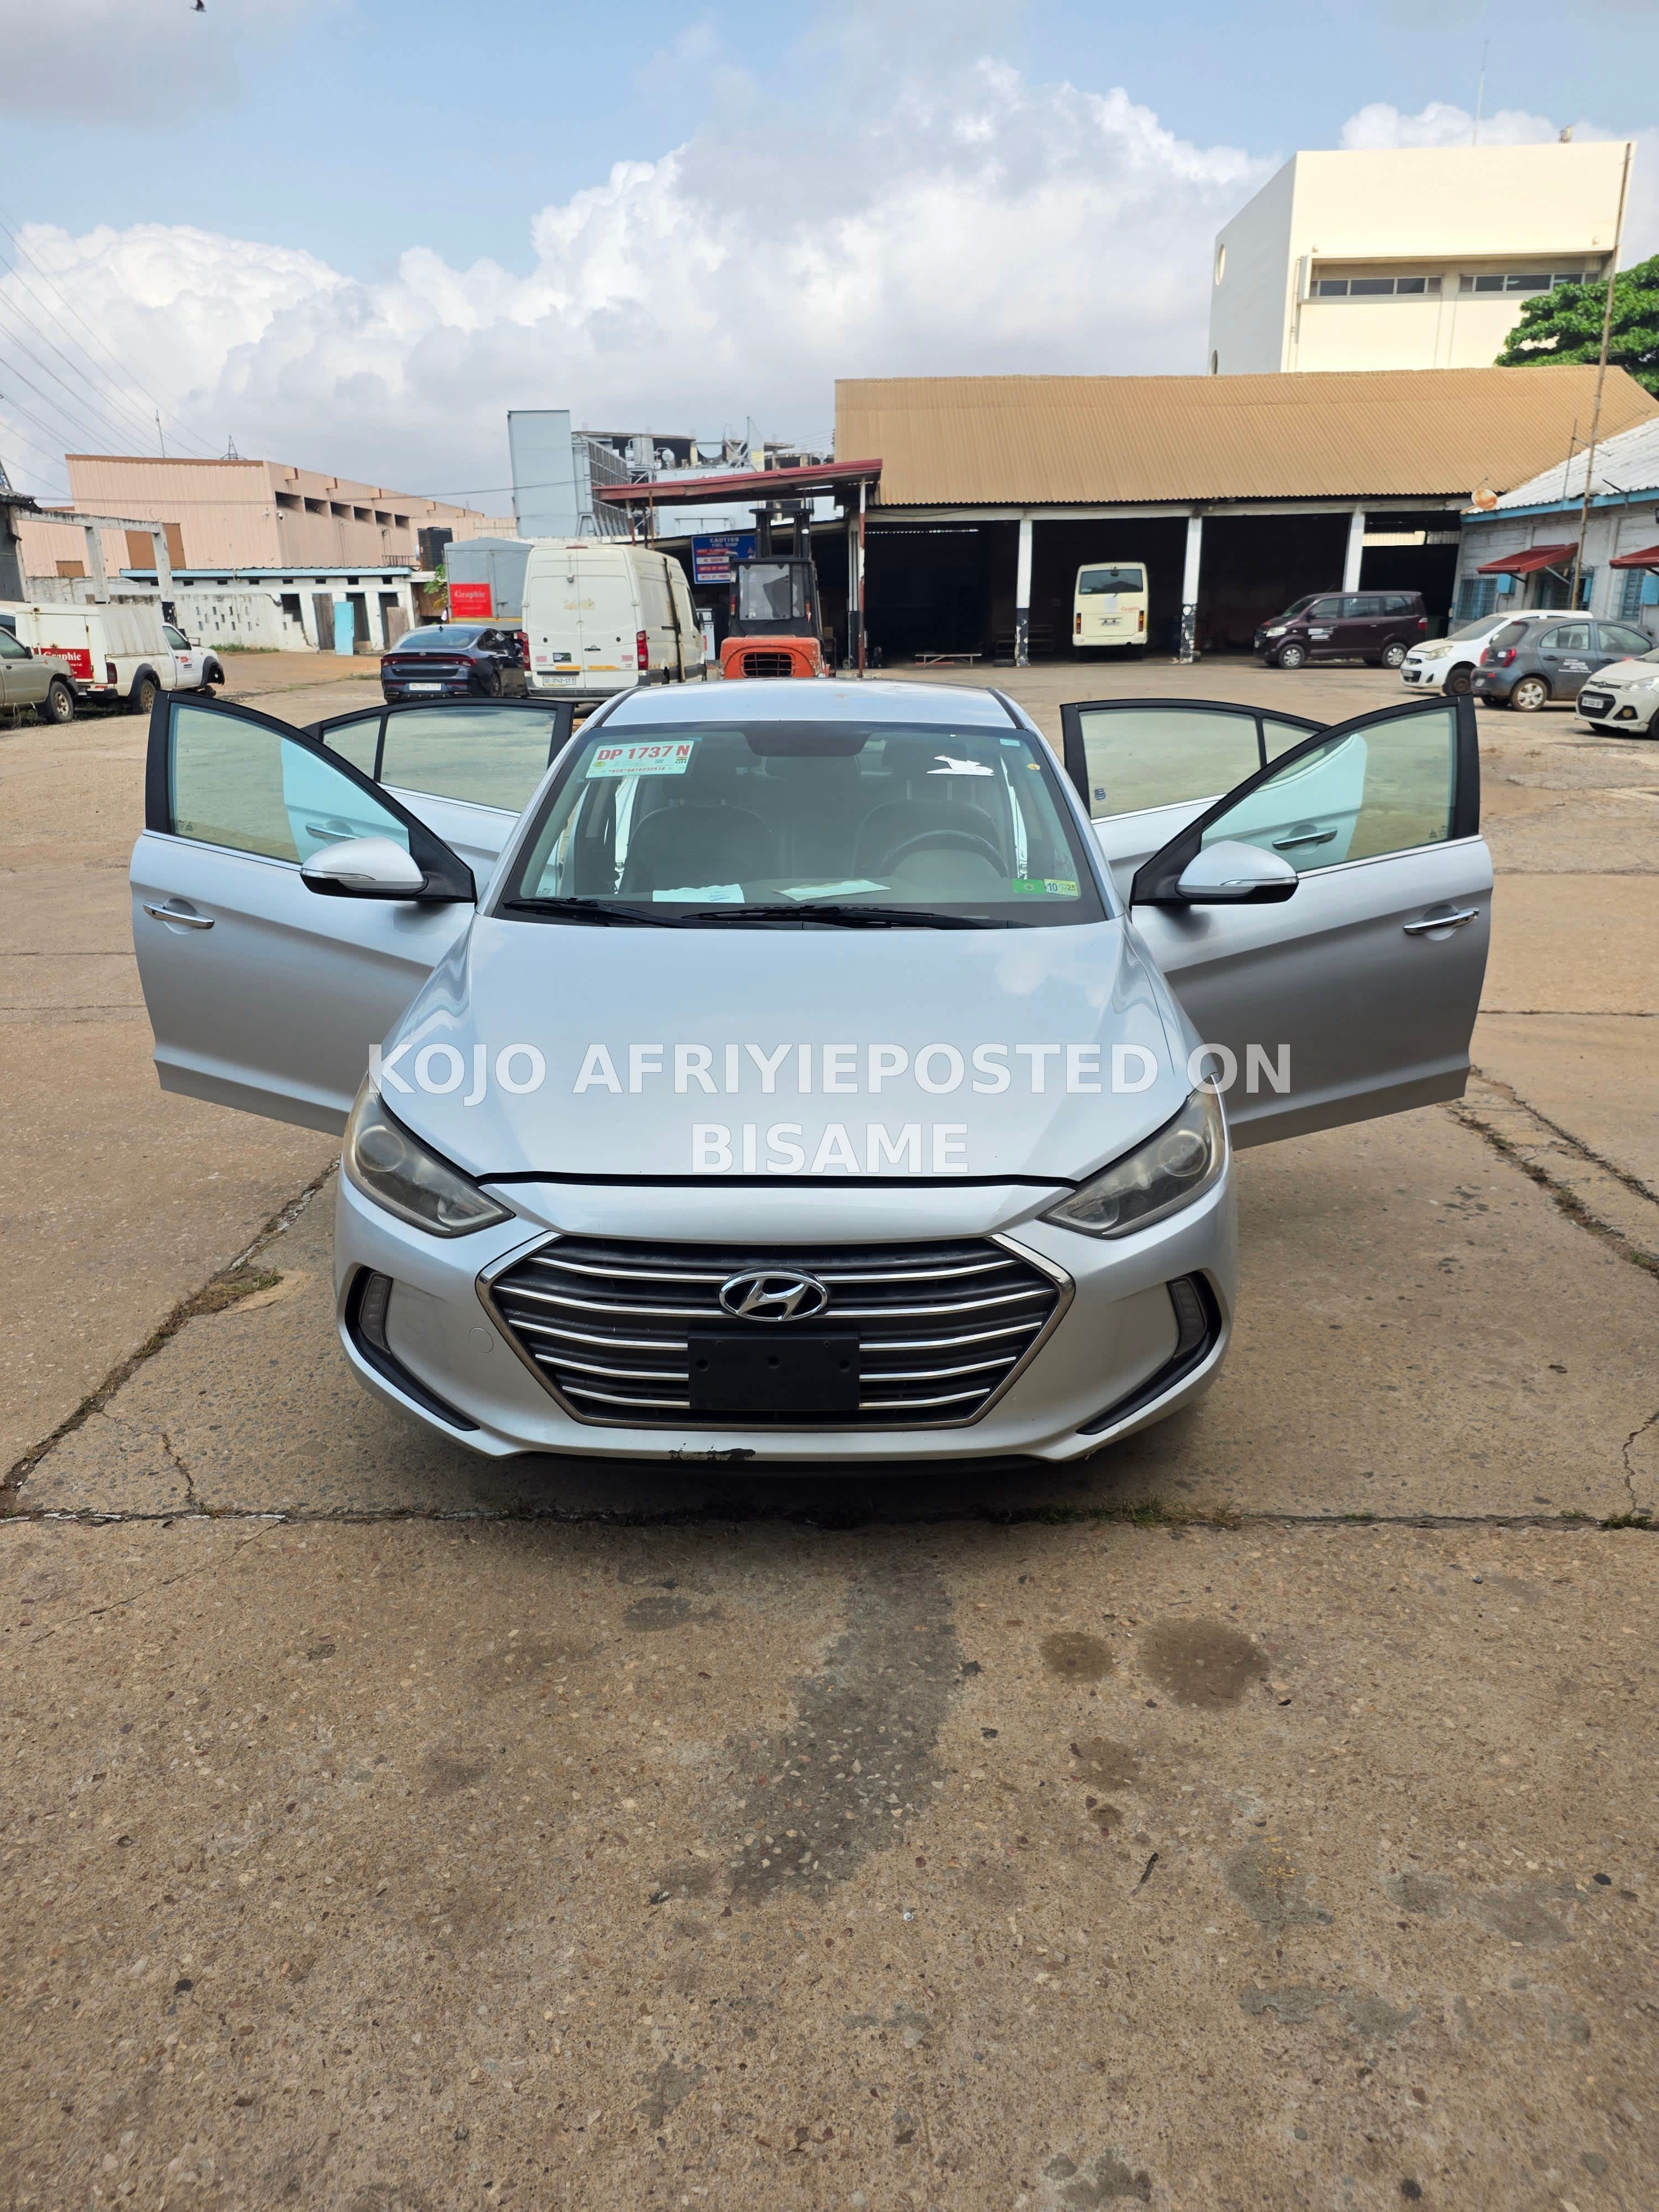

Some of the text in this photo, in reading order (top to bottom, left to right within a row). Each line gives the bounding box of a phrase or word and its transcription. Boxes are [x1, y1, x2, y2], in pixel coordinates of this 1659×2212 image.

[454, 589, 486, 599] Graphic
[597, 745, 691, 760] DP 1737 N
[1047, 883, 1058, 891] 10
